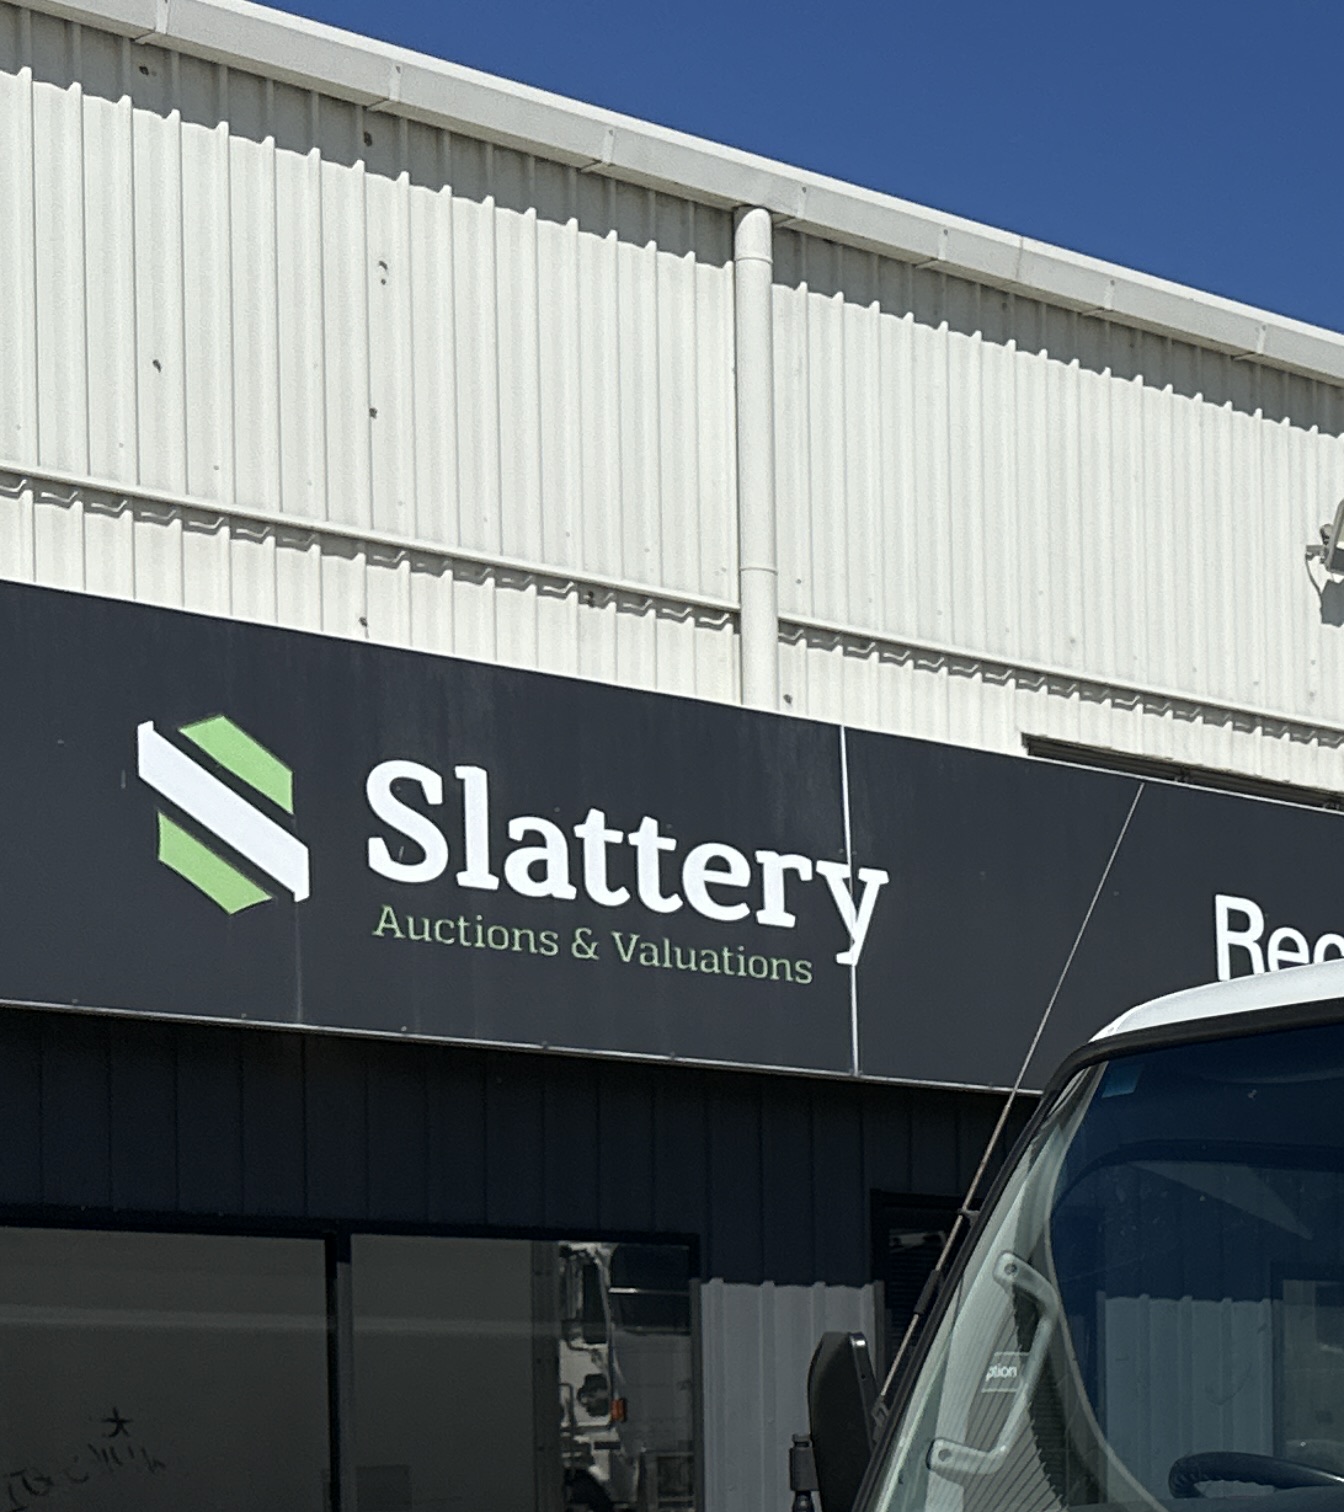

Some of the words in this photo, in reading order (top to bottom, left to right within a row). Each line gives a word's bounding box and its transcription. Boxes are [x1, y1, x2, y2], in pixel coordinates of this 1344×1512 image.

[366, 759, 889, 966] Slattery
[373, 904, 559, 957] Auctions
[570, 927, 600, 960] &
[611, 930, 813, 985] Valuations
